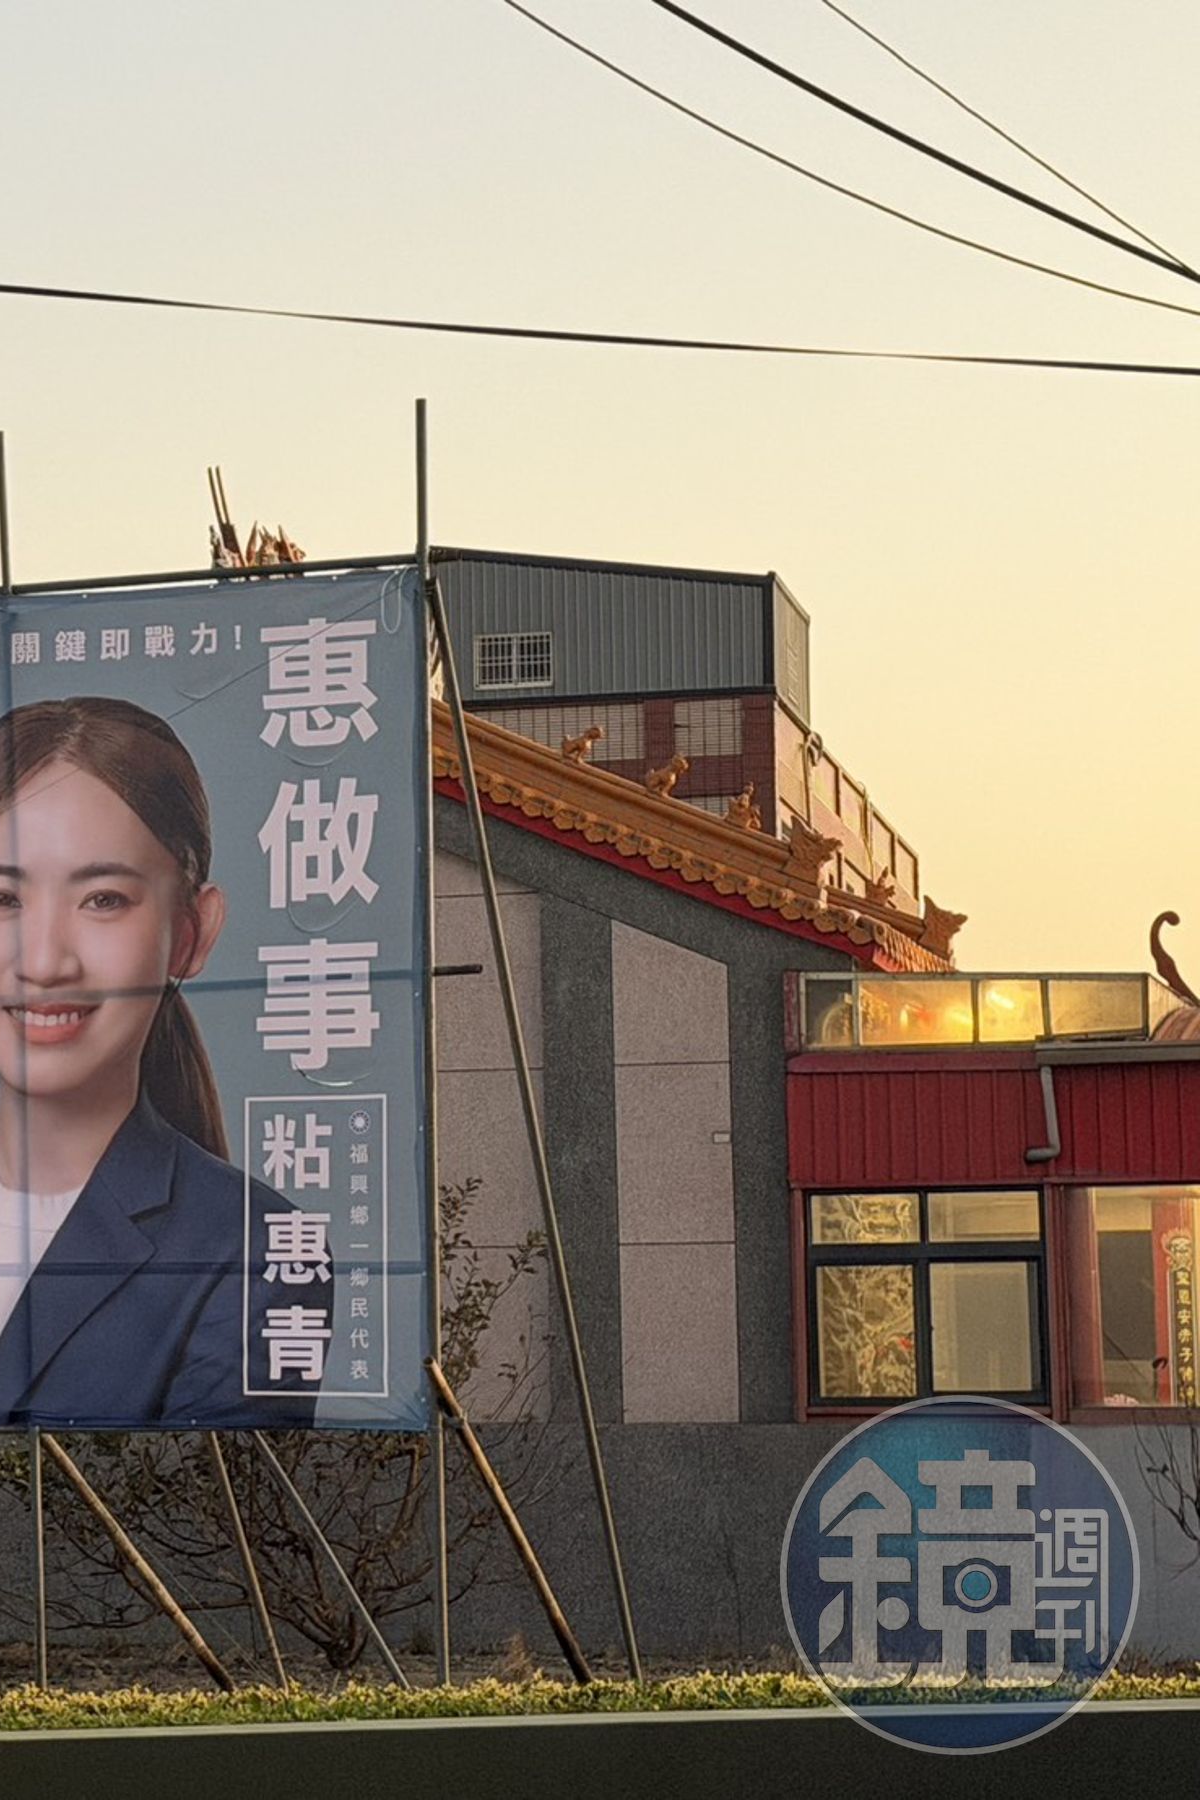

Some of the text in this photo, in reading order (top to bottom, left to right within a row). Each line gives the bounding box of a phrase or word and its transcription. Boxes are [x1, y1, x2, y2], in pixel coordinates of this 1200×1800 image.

[256, 617, 380, 1071] 惠做事
[261, 1113, 332, 1381] 粘惠青
